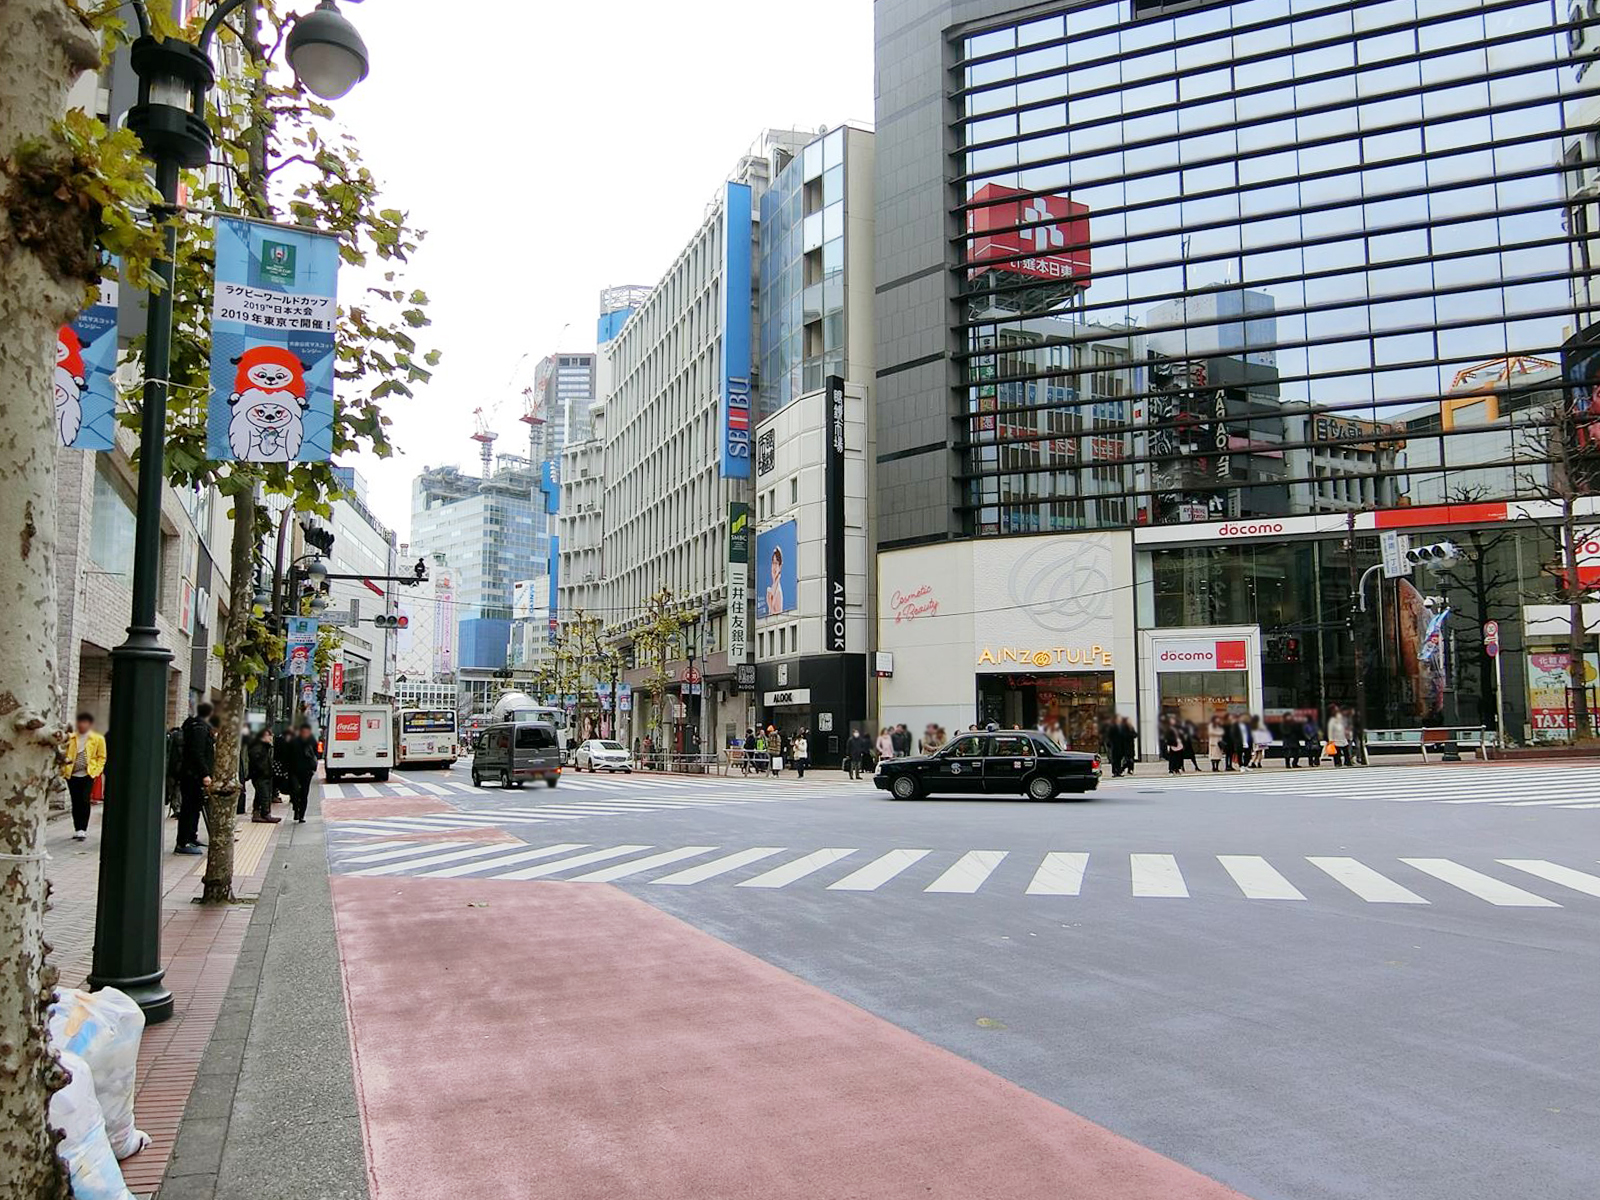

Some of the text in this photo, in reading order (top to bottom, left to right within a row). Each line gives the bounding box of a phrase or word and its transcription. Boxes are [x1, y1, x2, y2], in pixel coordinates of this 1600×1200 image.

[225, 285, 329, 307] ラグビーワールドカップ
[728, 377, 749, 458] SEIBU
[1219, 522, 1283, 537] docomo
[891, 585, 932, 610] Cosmetic
[731, 572, 745, 656] 三井住友銀行
[834, 581, 844, 649] ALOOK
[903, 598, 939, 621] Beauty
[1161, 650, 1213, 661] docomo
[774, 692, 793, 703] ALOOK
[336, 722, 359, 731] Coca-Cola
[1535, 714, 1566, 728] TAX
